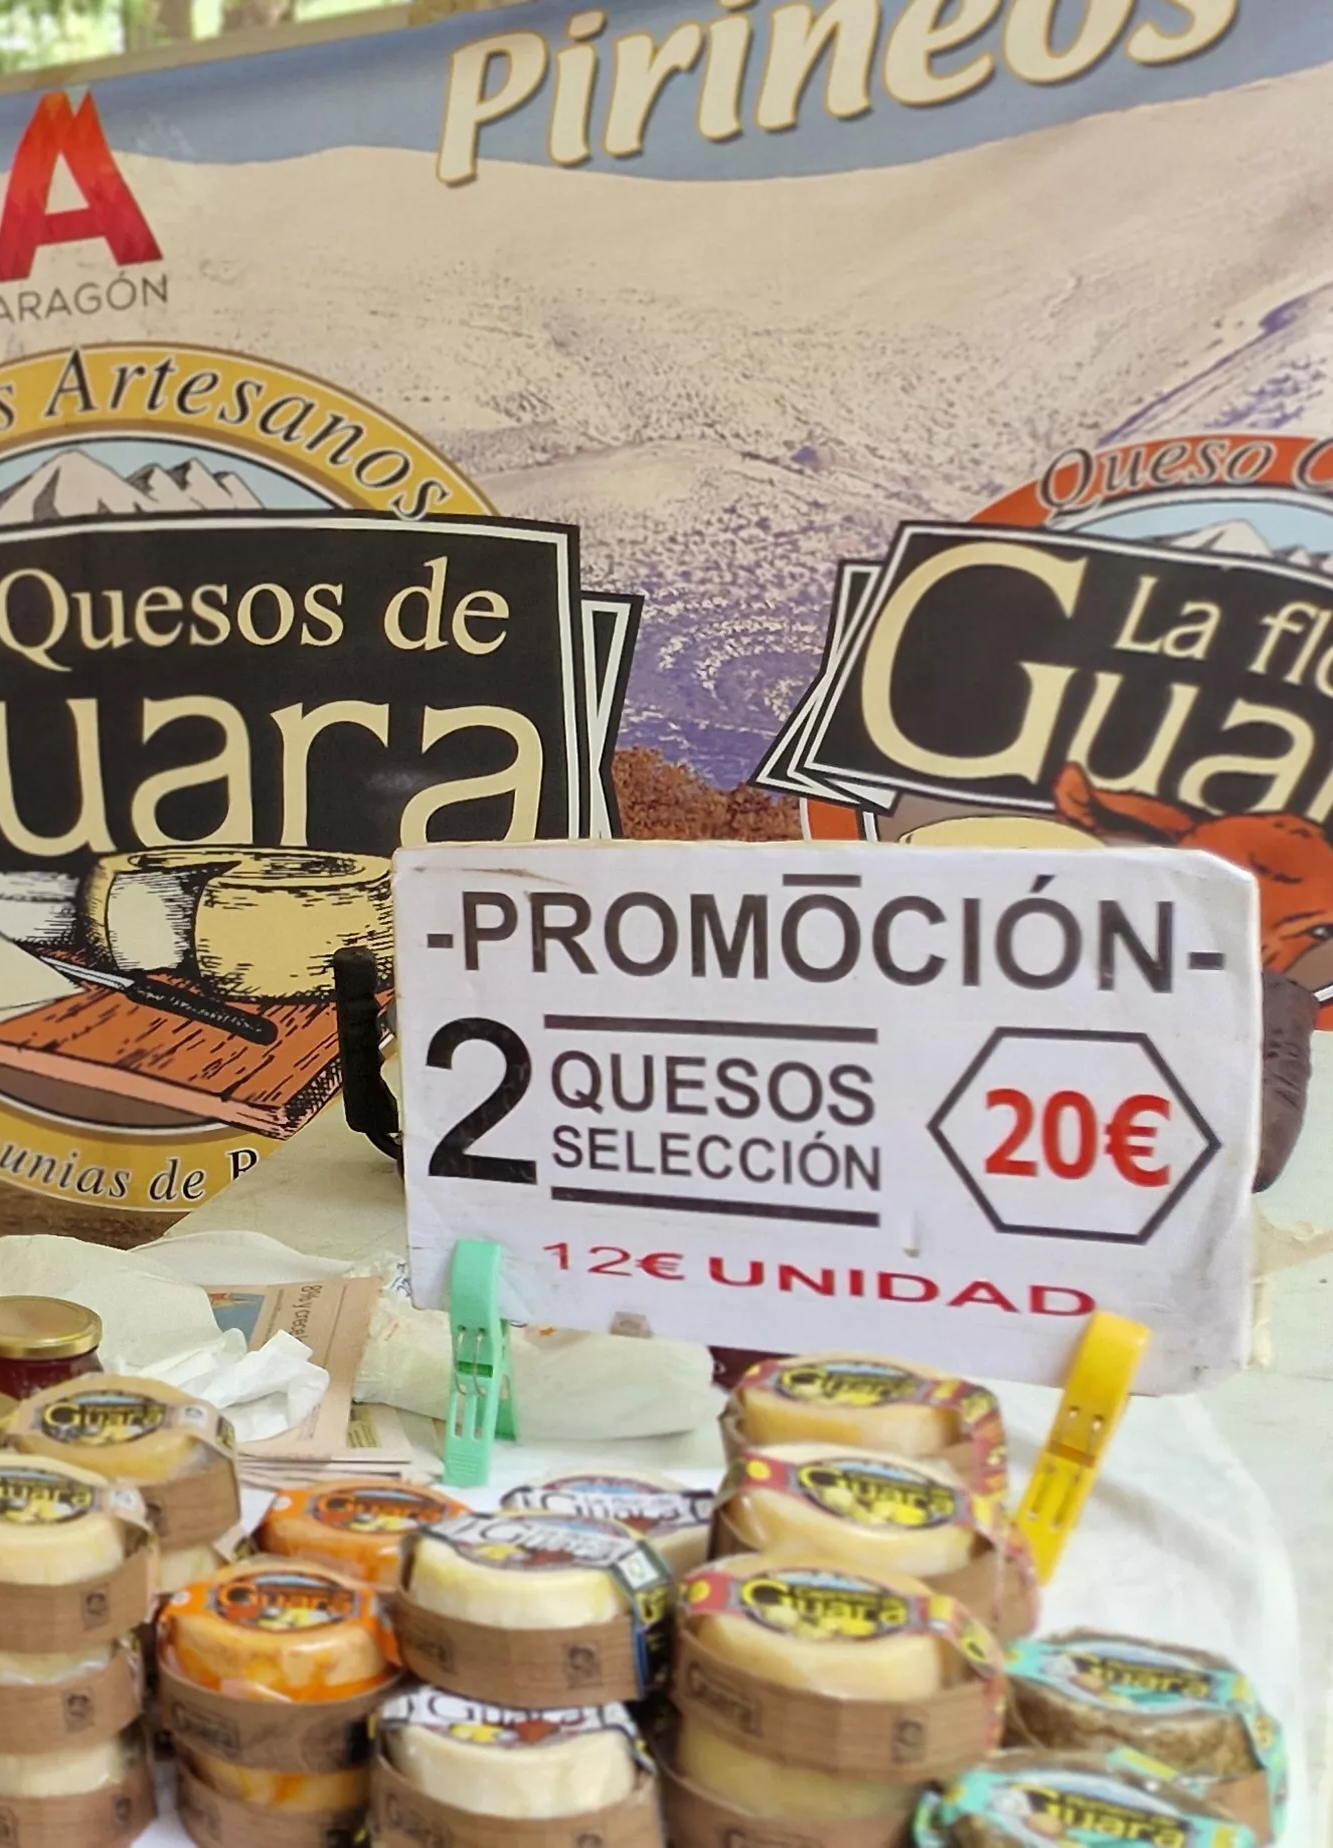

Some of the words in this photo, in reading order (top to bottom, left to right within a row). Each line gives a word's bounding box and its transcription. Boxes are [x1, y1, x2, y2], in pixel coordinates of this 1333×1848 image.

[437, 0, 1241, 187] Pirineos
[43, 348, 451, 522] Artesanos
[1037, 437, 1274, 519] Queso
[383, 558, 511, 656] de
[1112, 573, 1223, 661] La
[425, 1017, 538, 1186] 2
[550, 1049, 877, 1127] QUESOS
[148, 1156, 206, 1201] de
[552, 1123, 882, 1192] SELECCIÓN
[985, 1088, 1171, 1187] 20€
[542, 1242, 685, 1281] 12€
[707, 1255, 1095, 1319] UNIDAD
